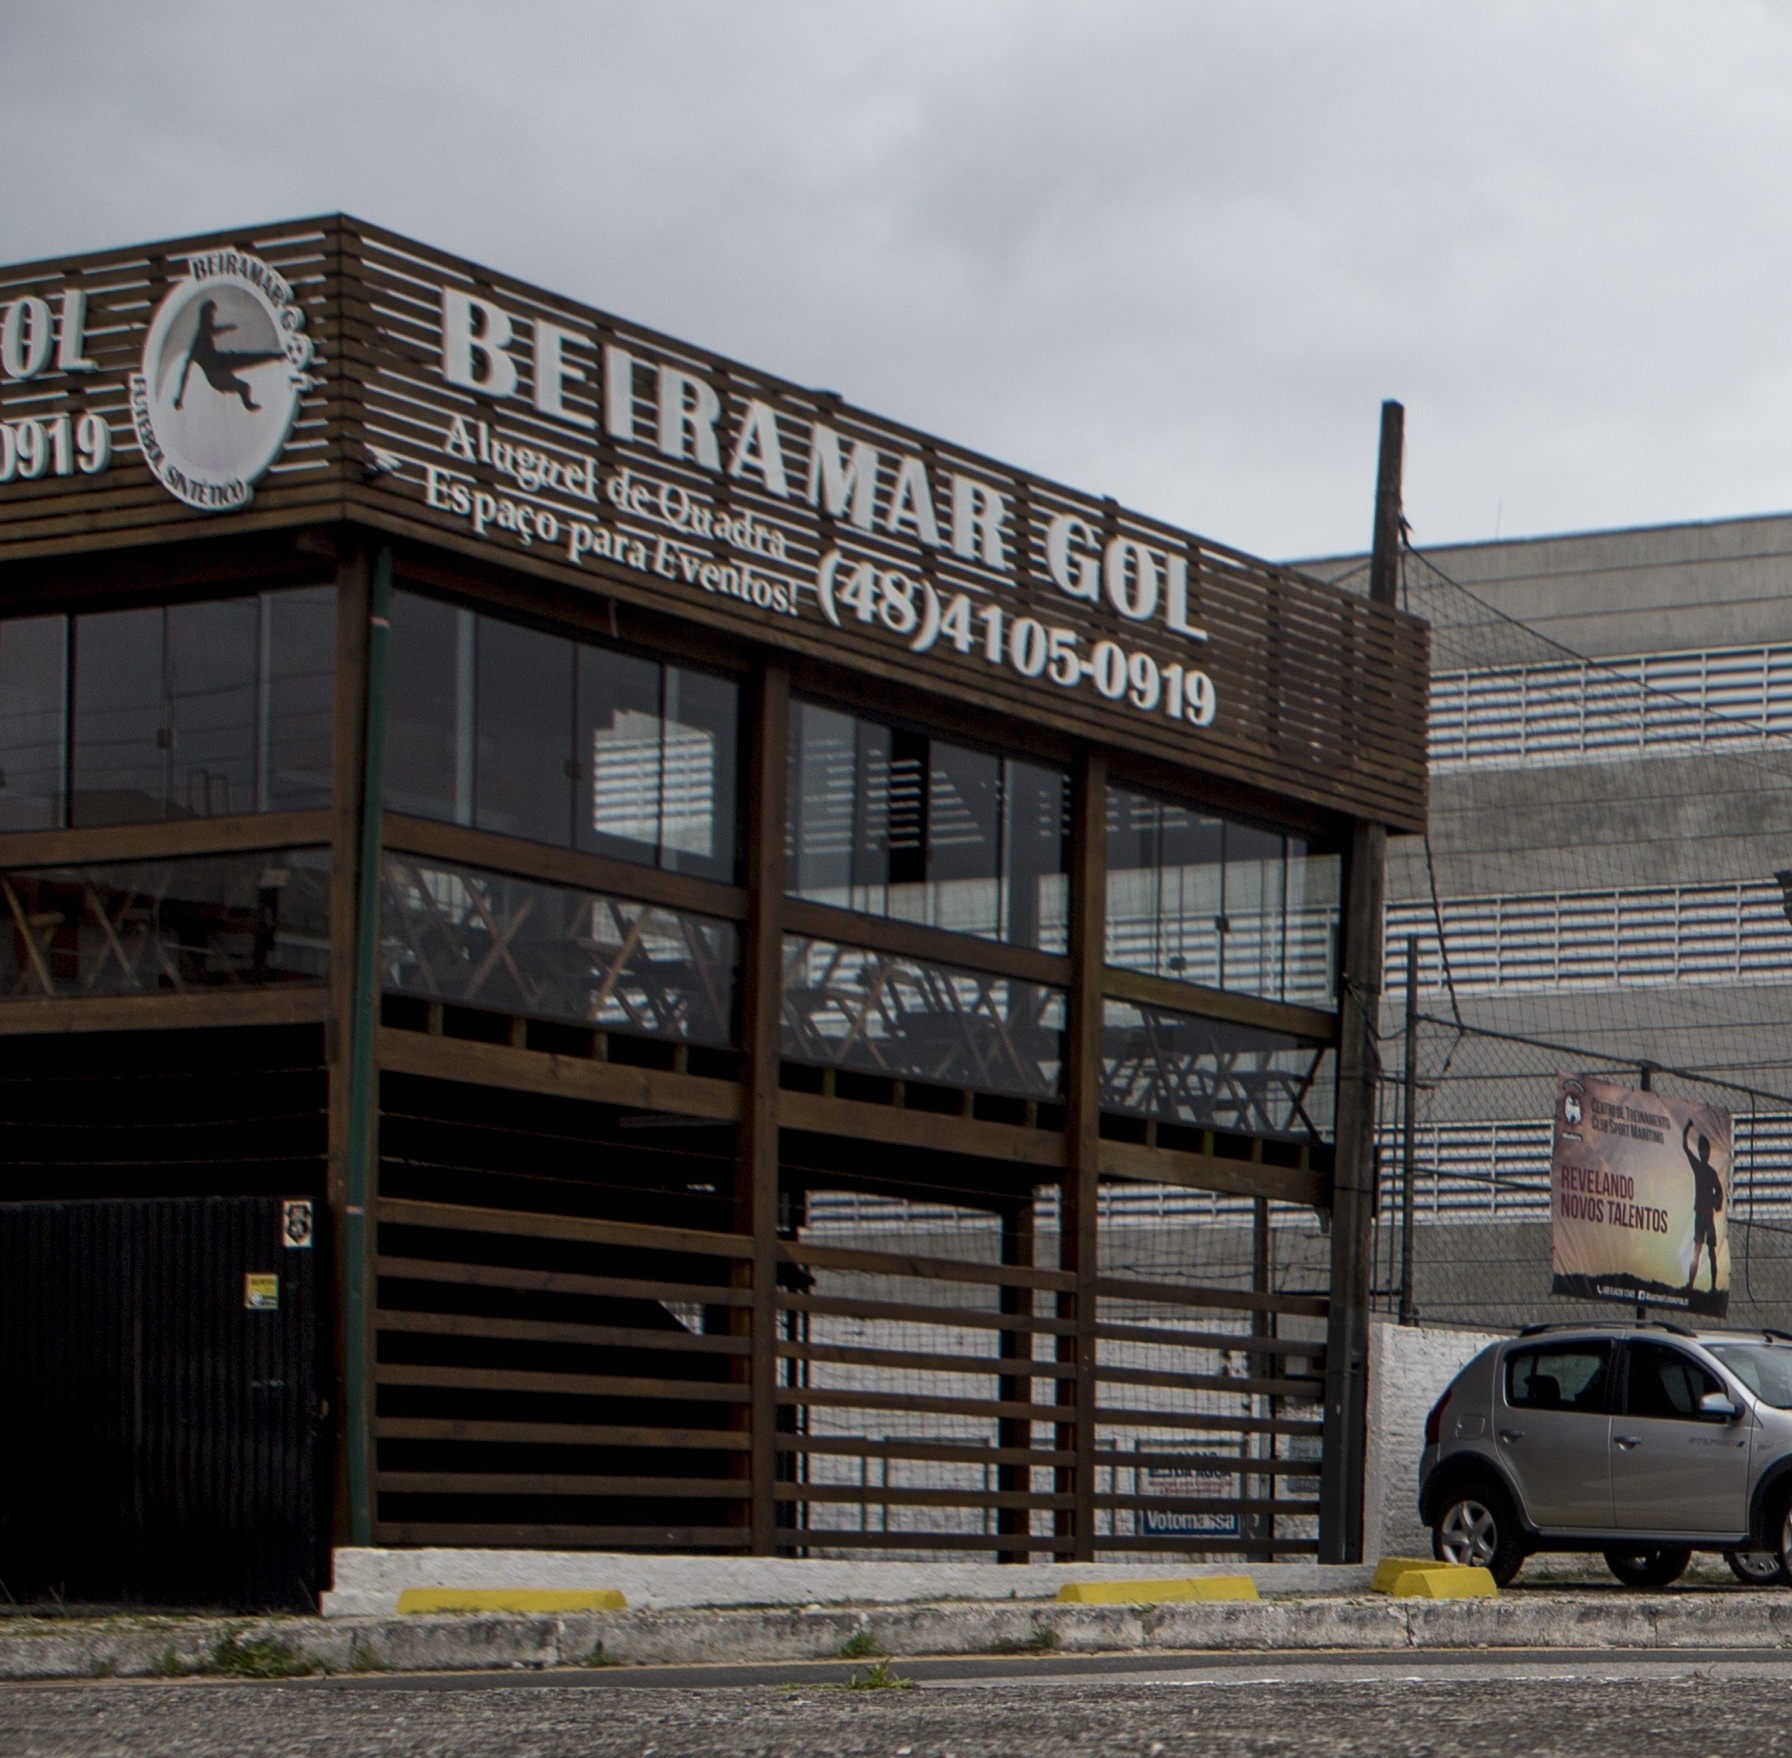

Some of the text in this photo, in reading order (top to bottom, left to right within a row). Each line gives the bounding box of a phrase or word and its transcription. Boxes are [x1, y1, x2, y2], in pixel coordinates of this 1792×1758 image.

[441, 285, 1209, 641] BEIRAMAR GOL
[444, 414, 788, 560] Aluguel de Quadra
[425, 464, 800, 617] Espaço para Eventos!
[1561, 1164, 1635, 1200] REVELANDO
[1561, 1192, 1669, 1234] NOVOS TALENTOS
[1146, 1509, 1235, 1530] Votomassa
